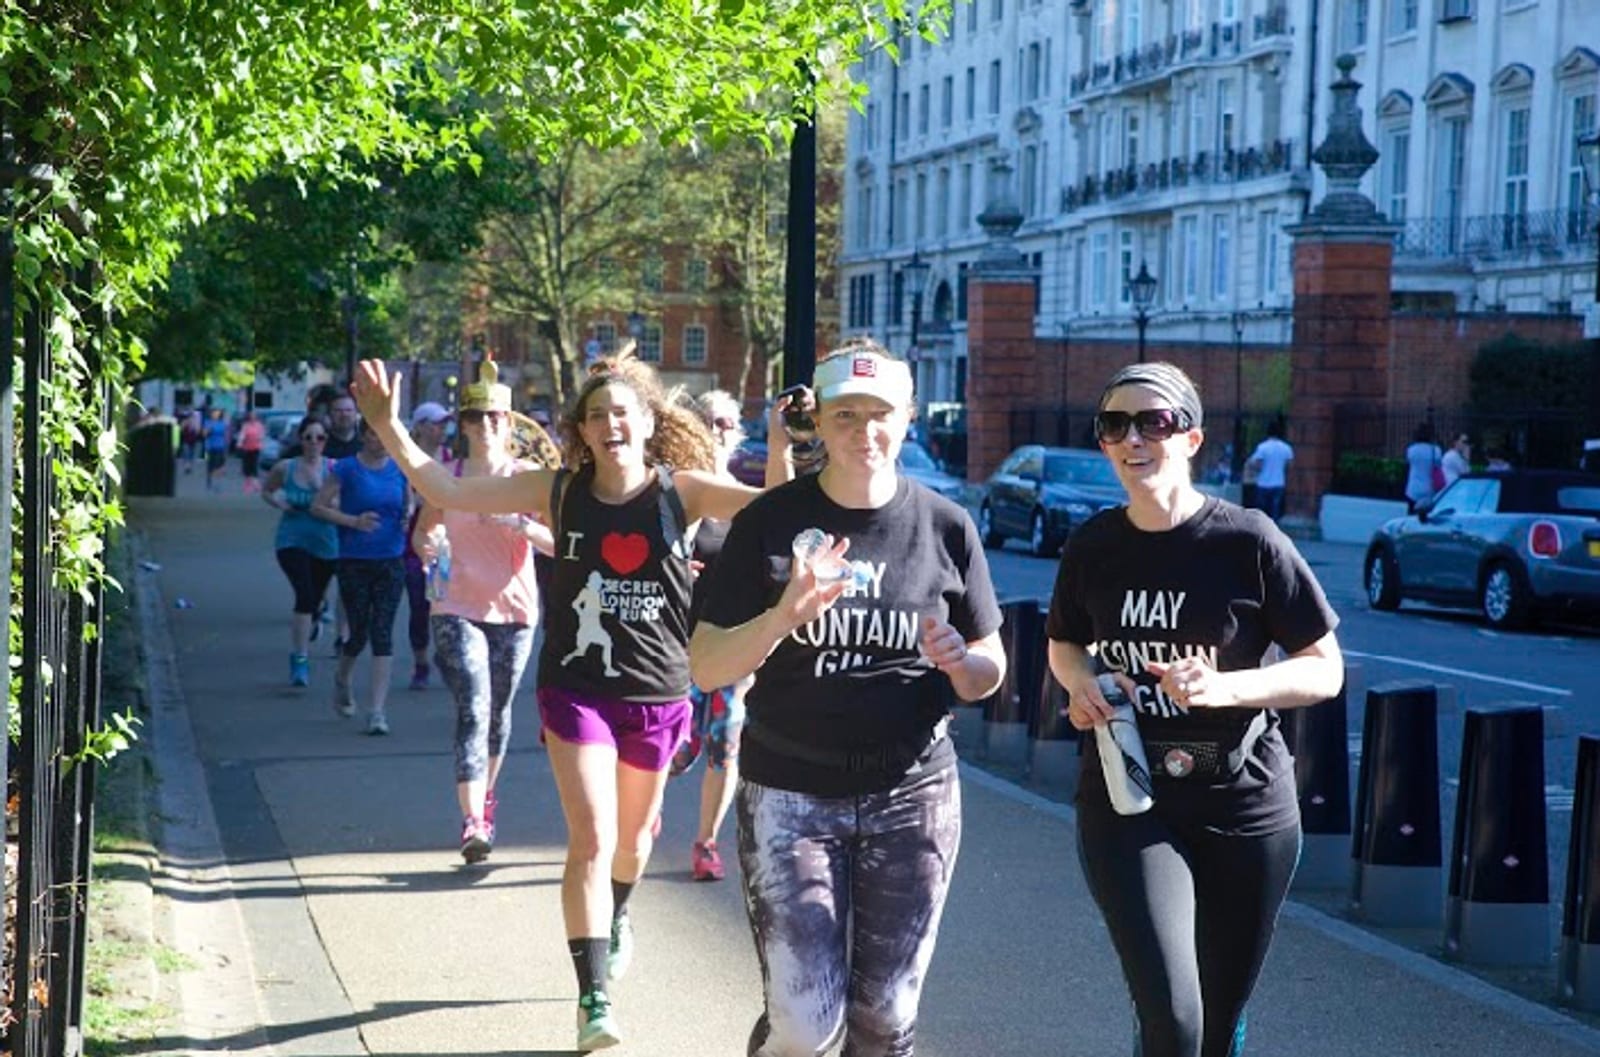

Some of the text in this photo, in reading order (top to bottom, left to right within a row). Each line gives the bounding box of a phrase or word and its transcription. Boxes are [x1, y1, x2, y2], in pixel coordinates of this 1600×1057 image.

[563, 532, 584, 560] I
[602, 579, 660, 595] SECRET
[600, 590, 665, 609] LONDON
[620, 608, 660, 622] RUNS
[1121, 590, 1186, 630] MAY
